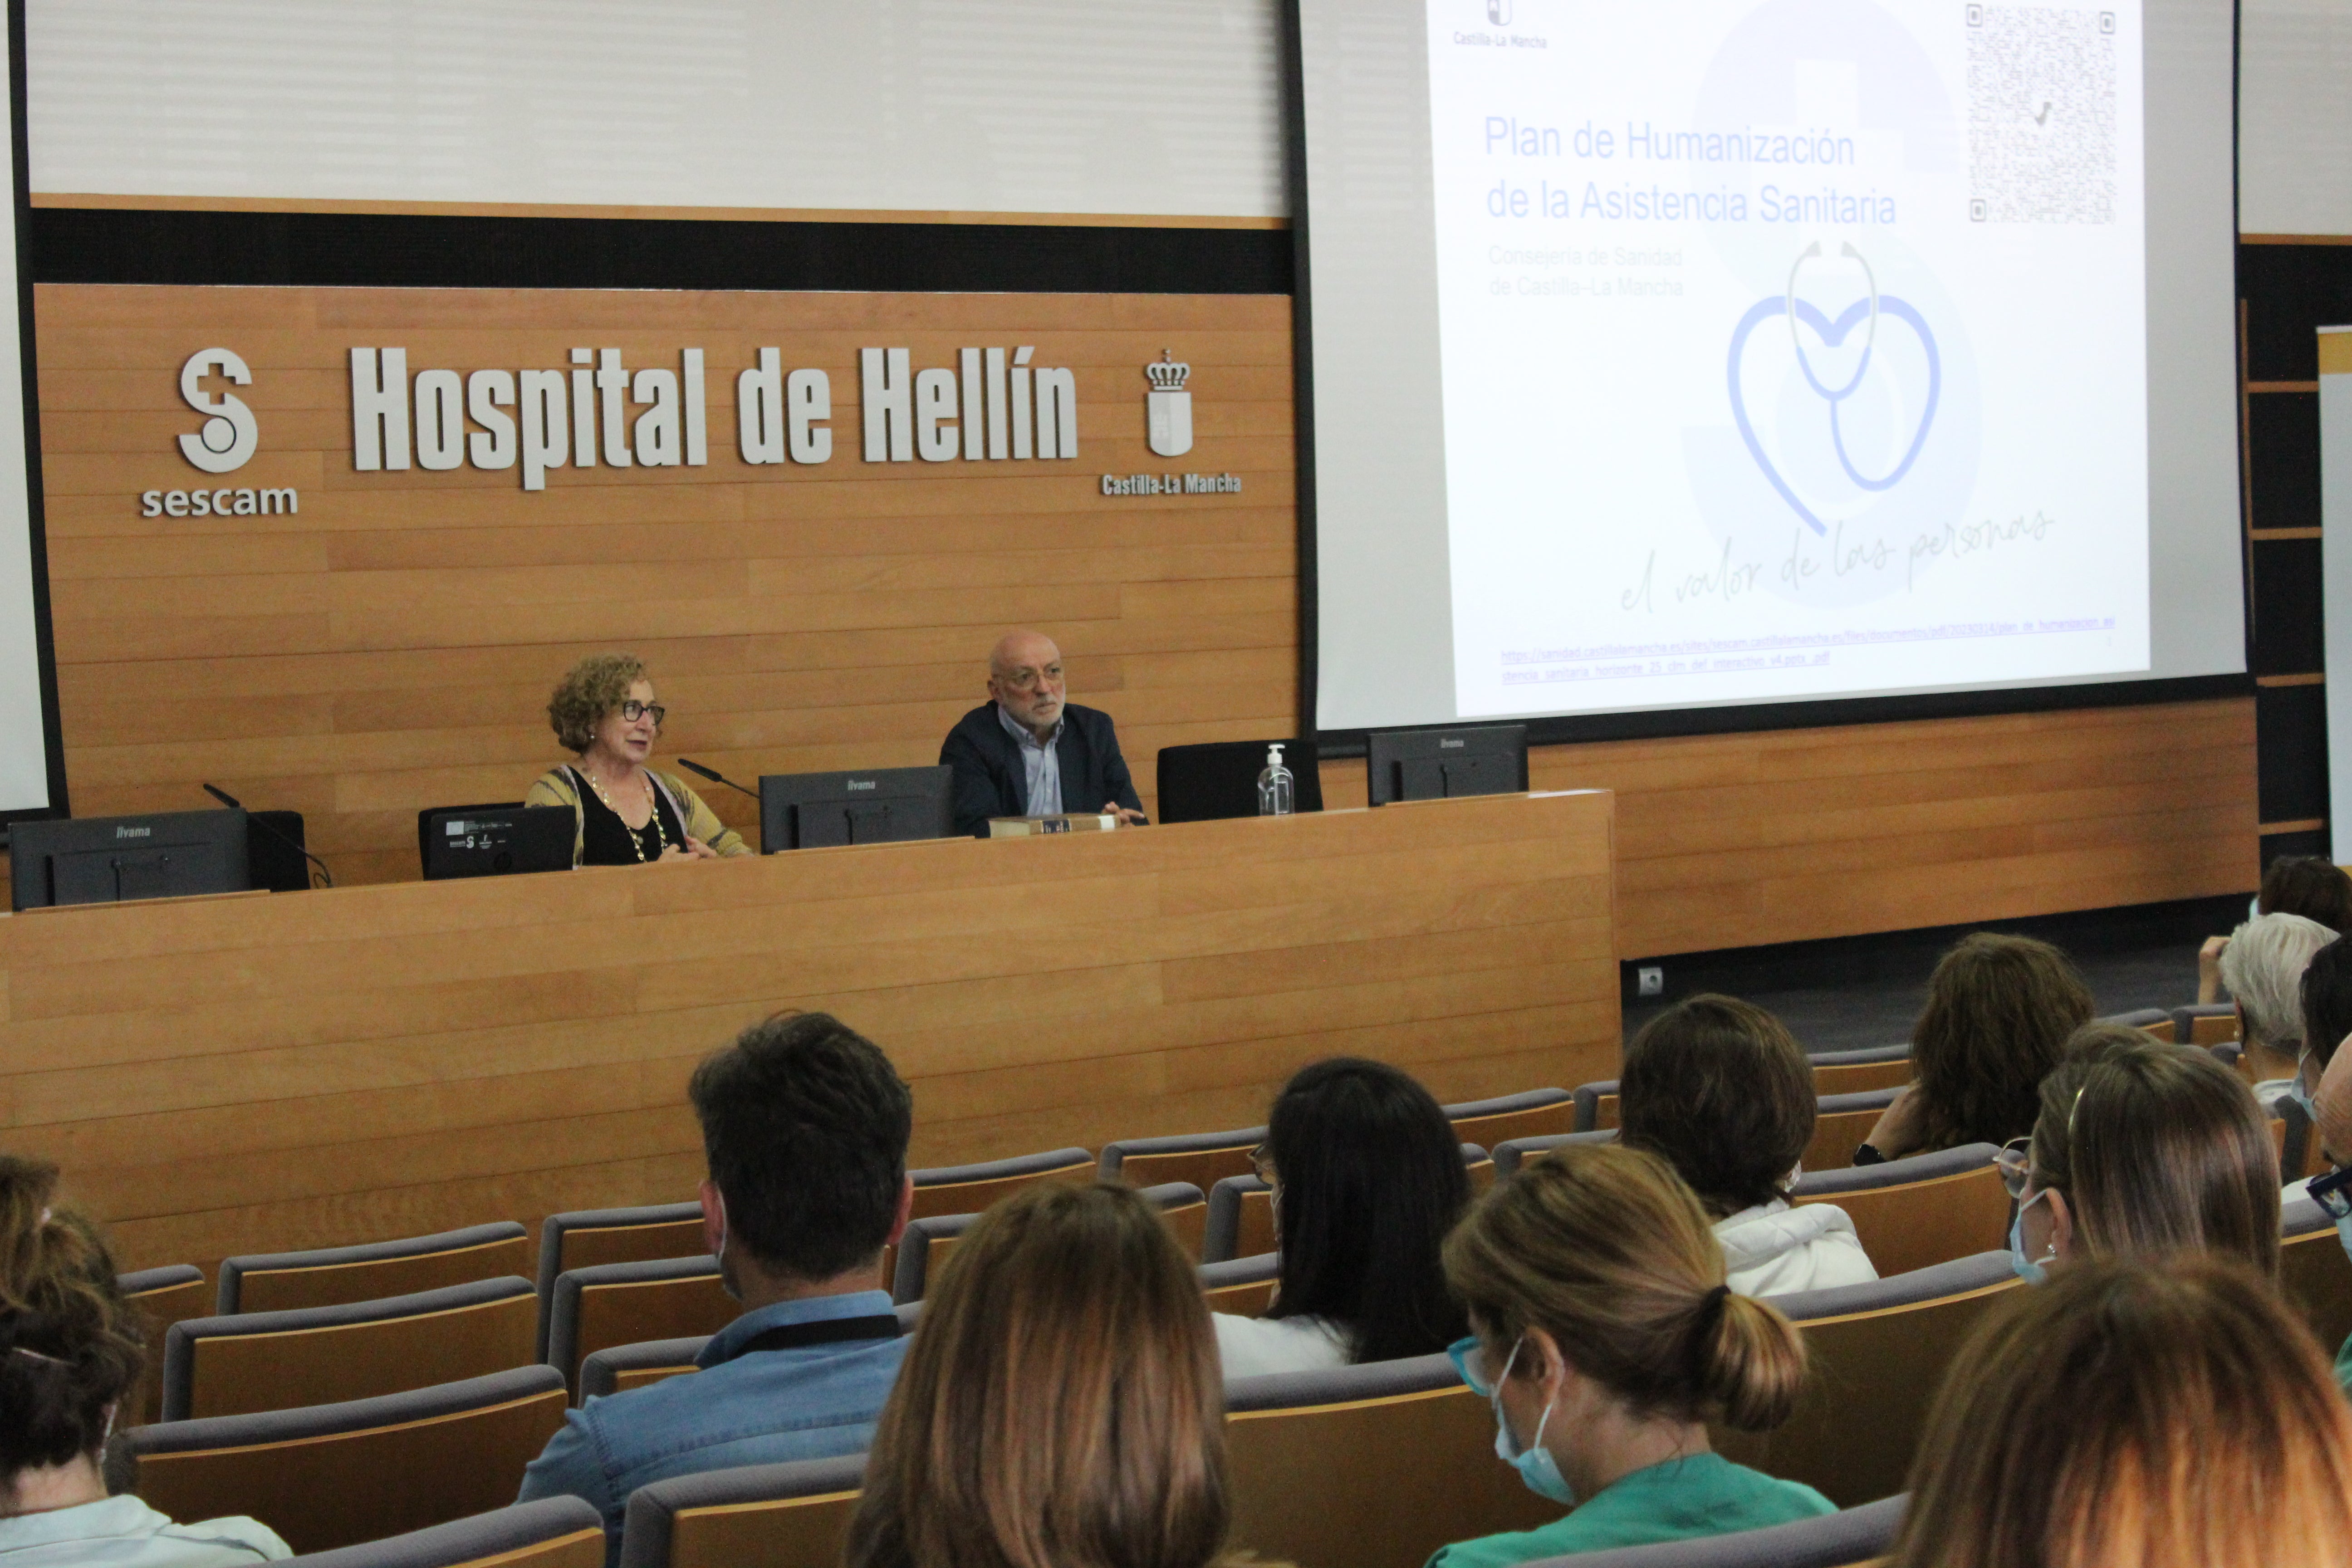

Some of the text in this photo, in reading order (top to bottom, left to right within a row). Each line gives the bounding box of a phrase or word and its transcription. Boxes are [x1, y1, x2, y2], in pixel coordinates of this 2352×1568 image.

[1511, 34, 1548, 49] Mancha
[1485, 117, 1854, 165] Plan de Humanización
[1487, 180, 1896, 224] de la Asistencia Sanitaria
[1588, 246, 1609, 266] de
[1614, 247, 1682, 266] Sanidad
[1490, 276, 1512, 296] de
[1618, 277, 1684, 297] Mancha
[351, 346, 1078, 490] Hospital de Hellín
[1102, 473, 1241, 495] Castilla-La Mancha
[142, 488, 298, 517] sescam
[1621, 510, 2055, 613] el valor de las personas
